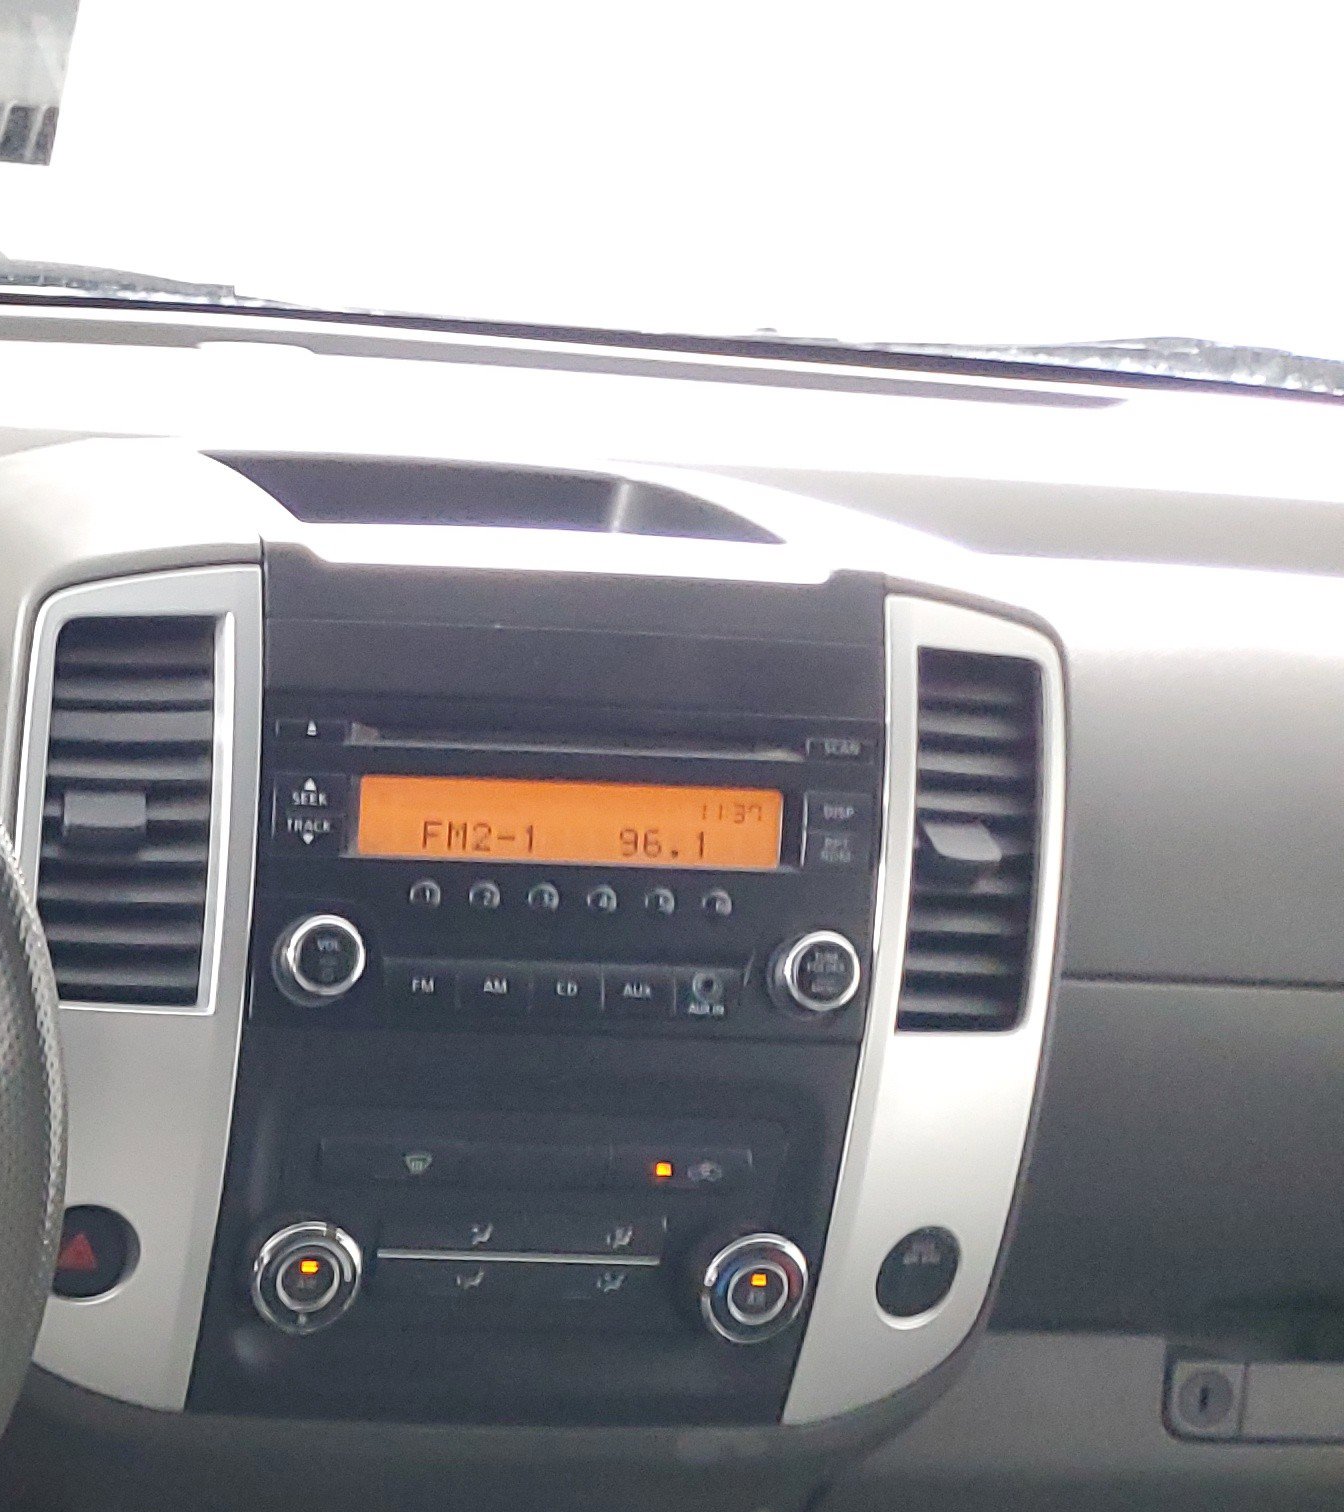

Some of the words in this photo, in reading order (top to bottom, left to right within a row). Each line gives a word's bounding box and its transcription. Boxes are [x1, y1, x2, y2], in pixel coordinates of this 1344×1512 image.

[292, 791, 328, 806] SEEK
[286, 818, 331, 833] TRACK
[422, 819, 535, 854] FM2-1
[619, 827, 706, 860] 96.1
[412, 977, 435, 993] FM
[483, 977, 508, 994] AM
